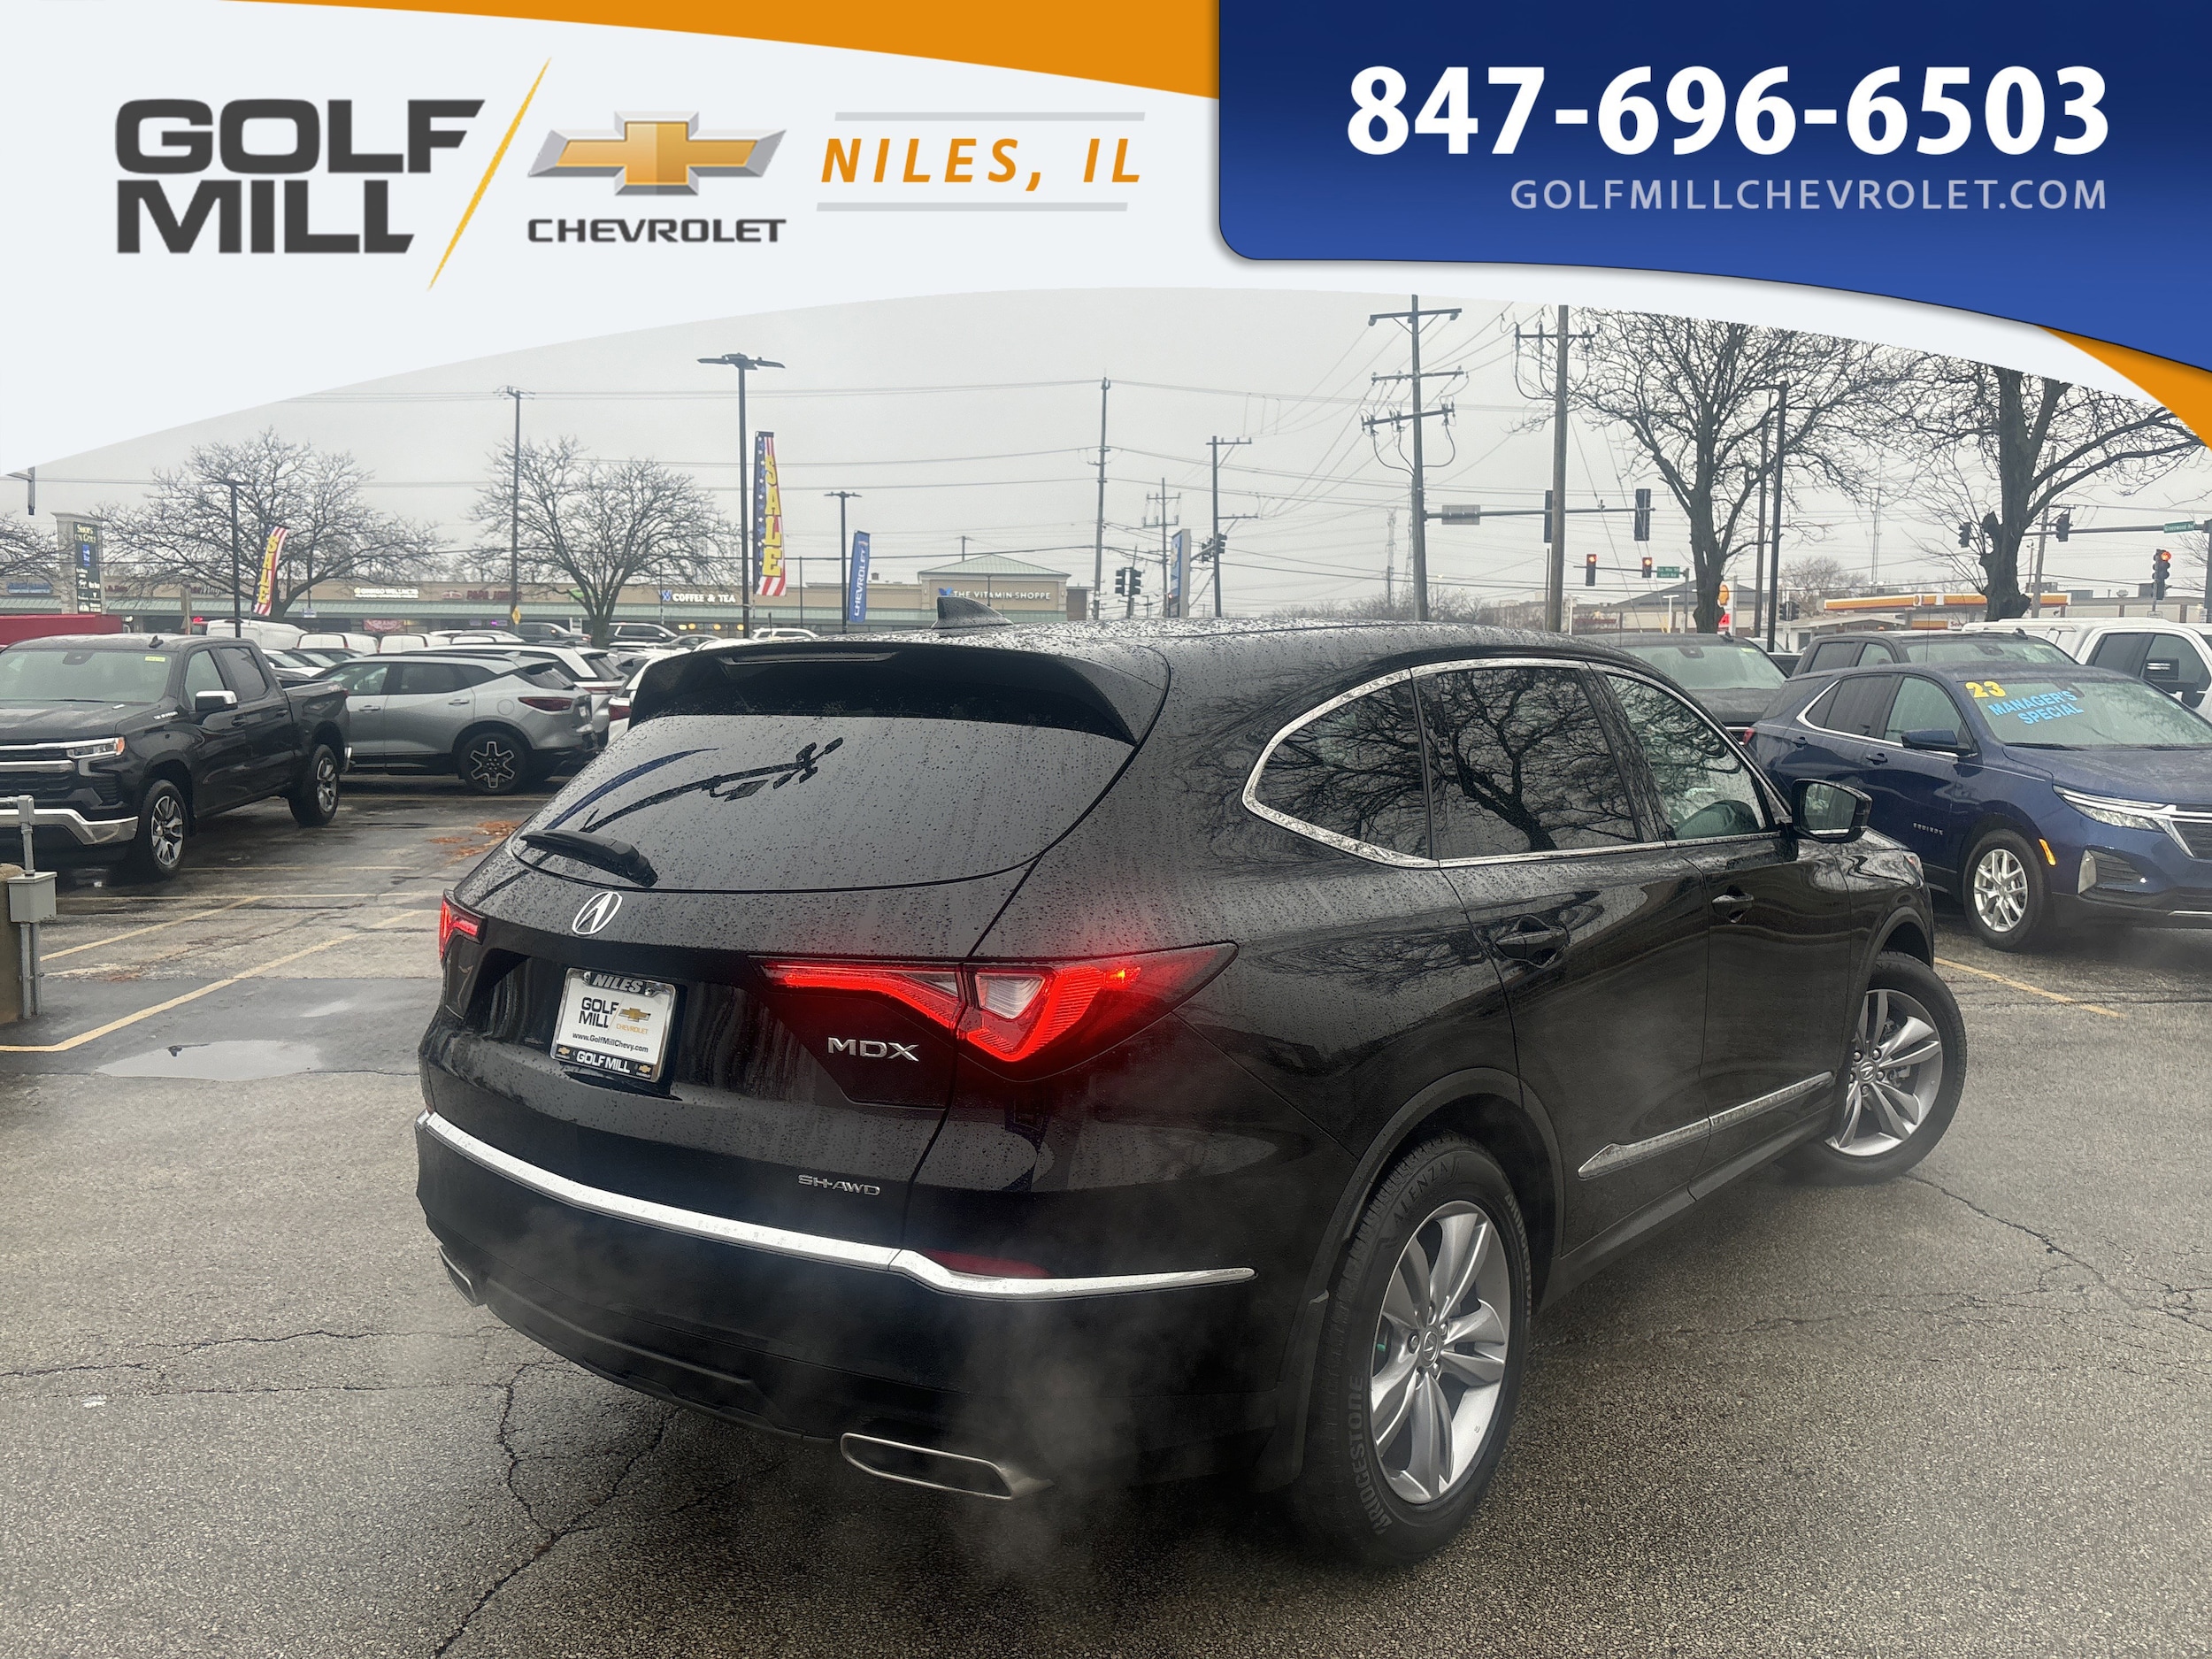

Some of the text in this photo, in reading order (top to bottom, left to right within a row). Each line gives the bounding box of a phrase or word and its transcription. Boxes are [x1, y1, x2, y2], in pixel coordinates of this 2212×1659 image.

[762, 455, 782, 577] SALE
[257, 535, 280, 604] SALE
[854, 549, 867, 617] CHEVROLET
[672, 593, 704, 603] COFFEE
[707, 594, 716, 603] &
[718, 594, 736, 603] TEA
[1965, 680, 2006, 698] 23
[1988, 690, 2078, 716] MANAGER'S
[2017, 703, 2085, 725] SPECIAL
[592, 974, 644, 993] NILES
[581, 997, 619, 1015] GOLF
[578, 1011, 609, 1028] MILL
[616, 1024, 649, 1034] CHEVROLET
[572, 1033, 649, 1053] www.GolfMillChevy.com
[827, 1036, 919, 1062] MDX
[576, 1050, 630, 1073] GOLF MILL
[798, 1174, 880, 1196] SH-AWD
[1348, 1375, 1393, 1536] BRIDGESTONE
